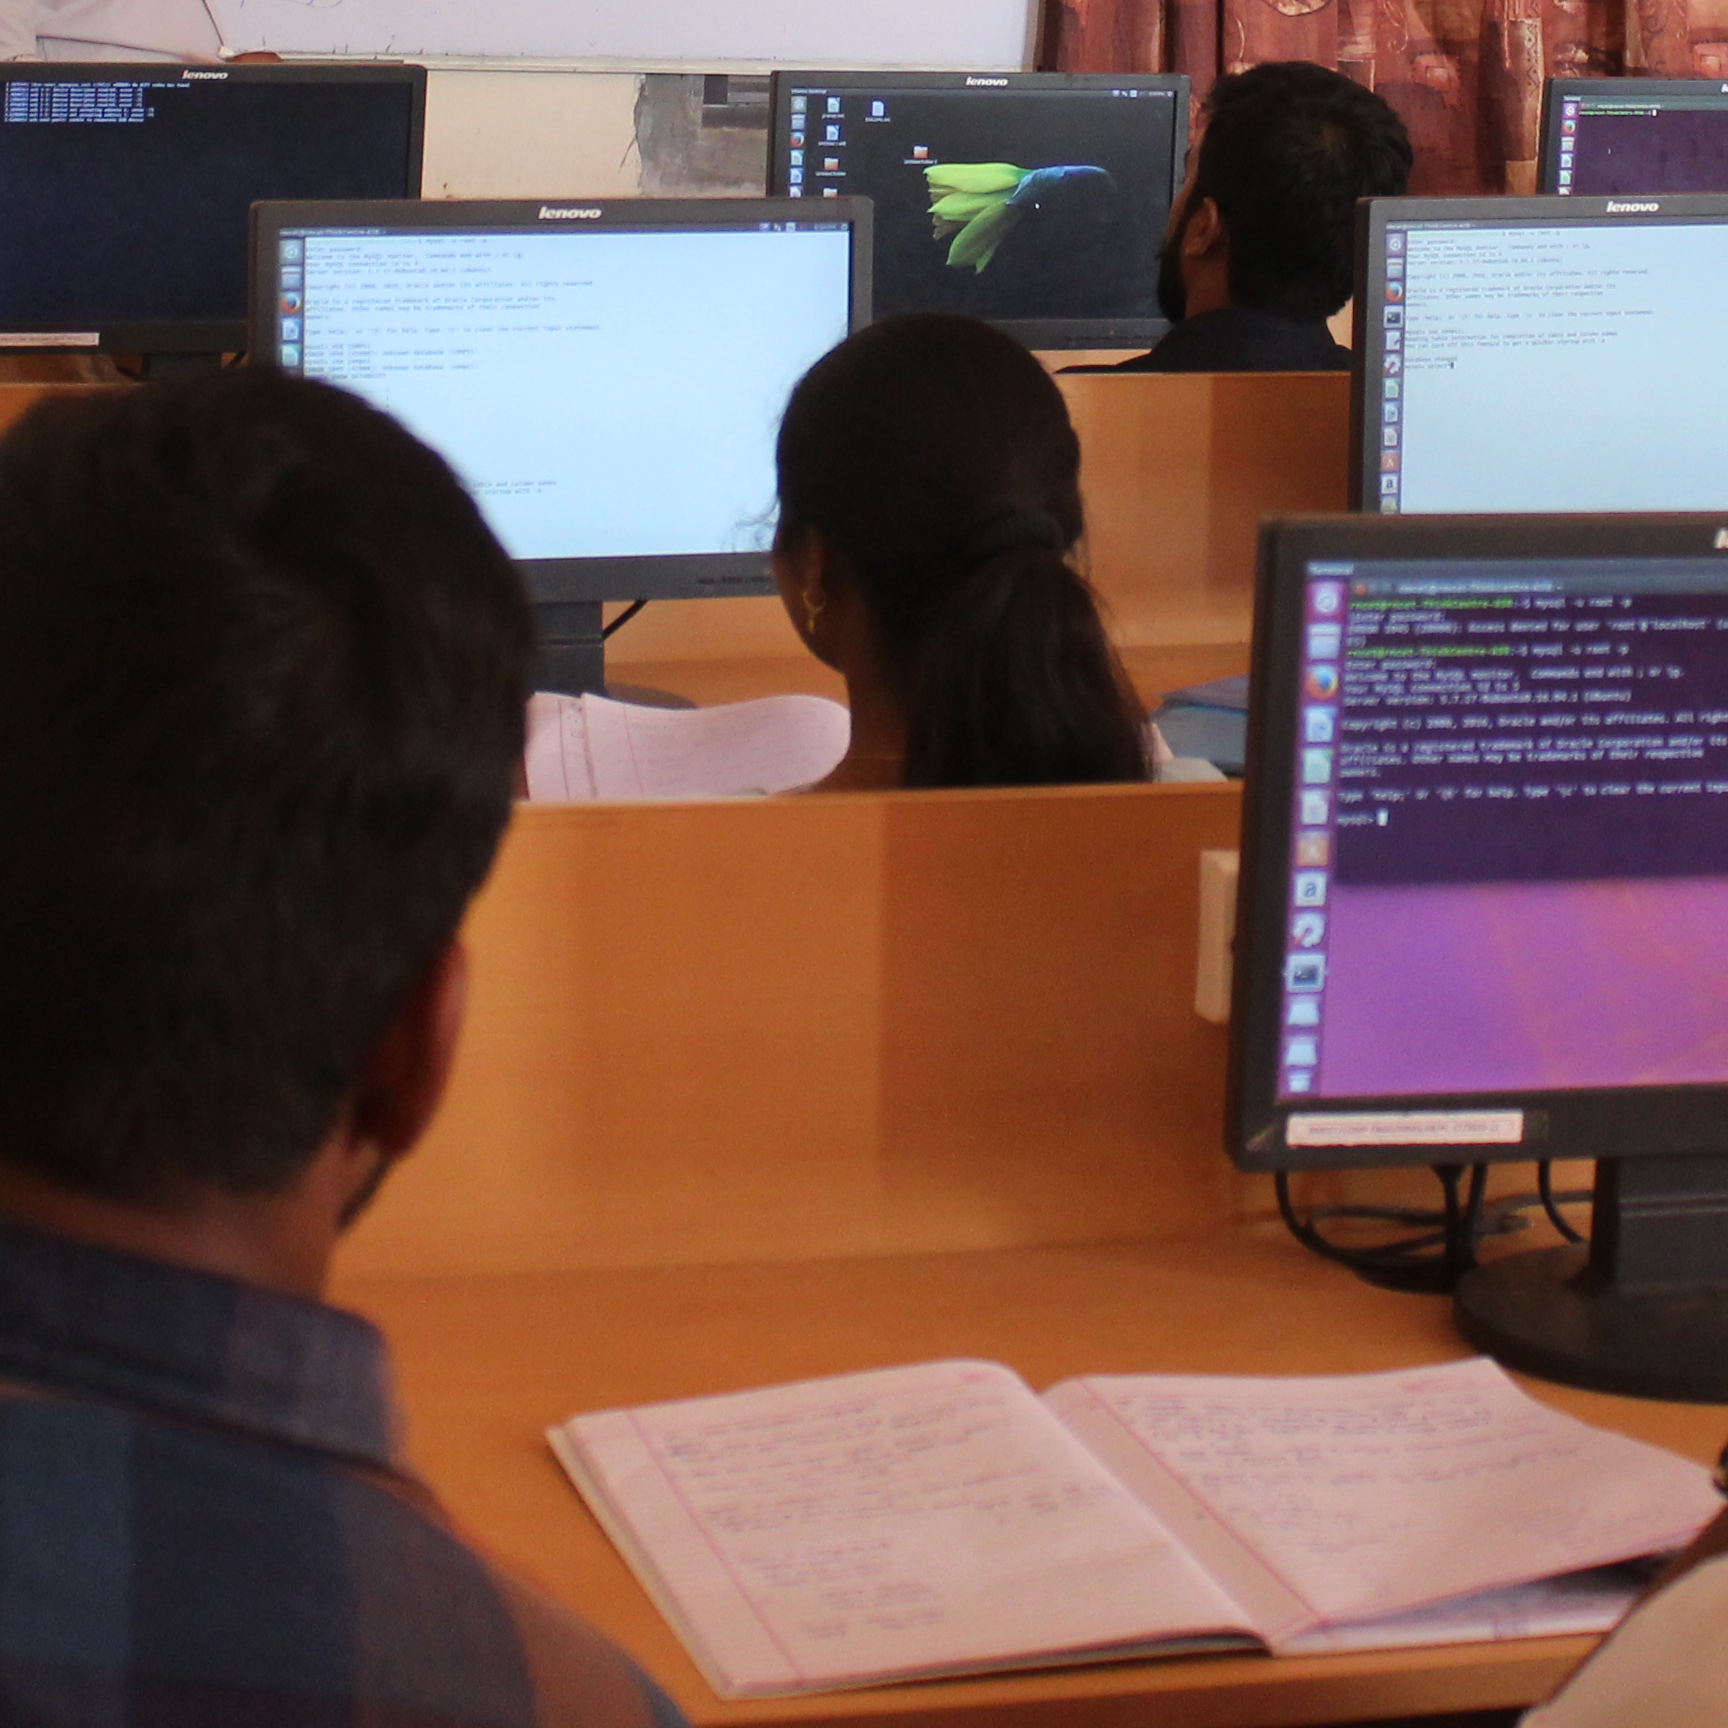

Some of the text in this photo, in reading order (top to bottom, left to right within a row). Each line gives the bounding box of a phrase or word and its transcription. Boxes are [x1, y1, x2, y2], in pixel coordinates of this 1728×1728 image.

[183, 70, 229, 80] lenovo
[966, 76, 1008, 86] lenovo
[1606, 200, 1659, 213] lenovo
[539, 206, 602, 220] lenovo
